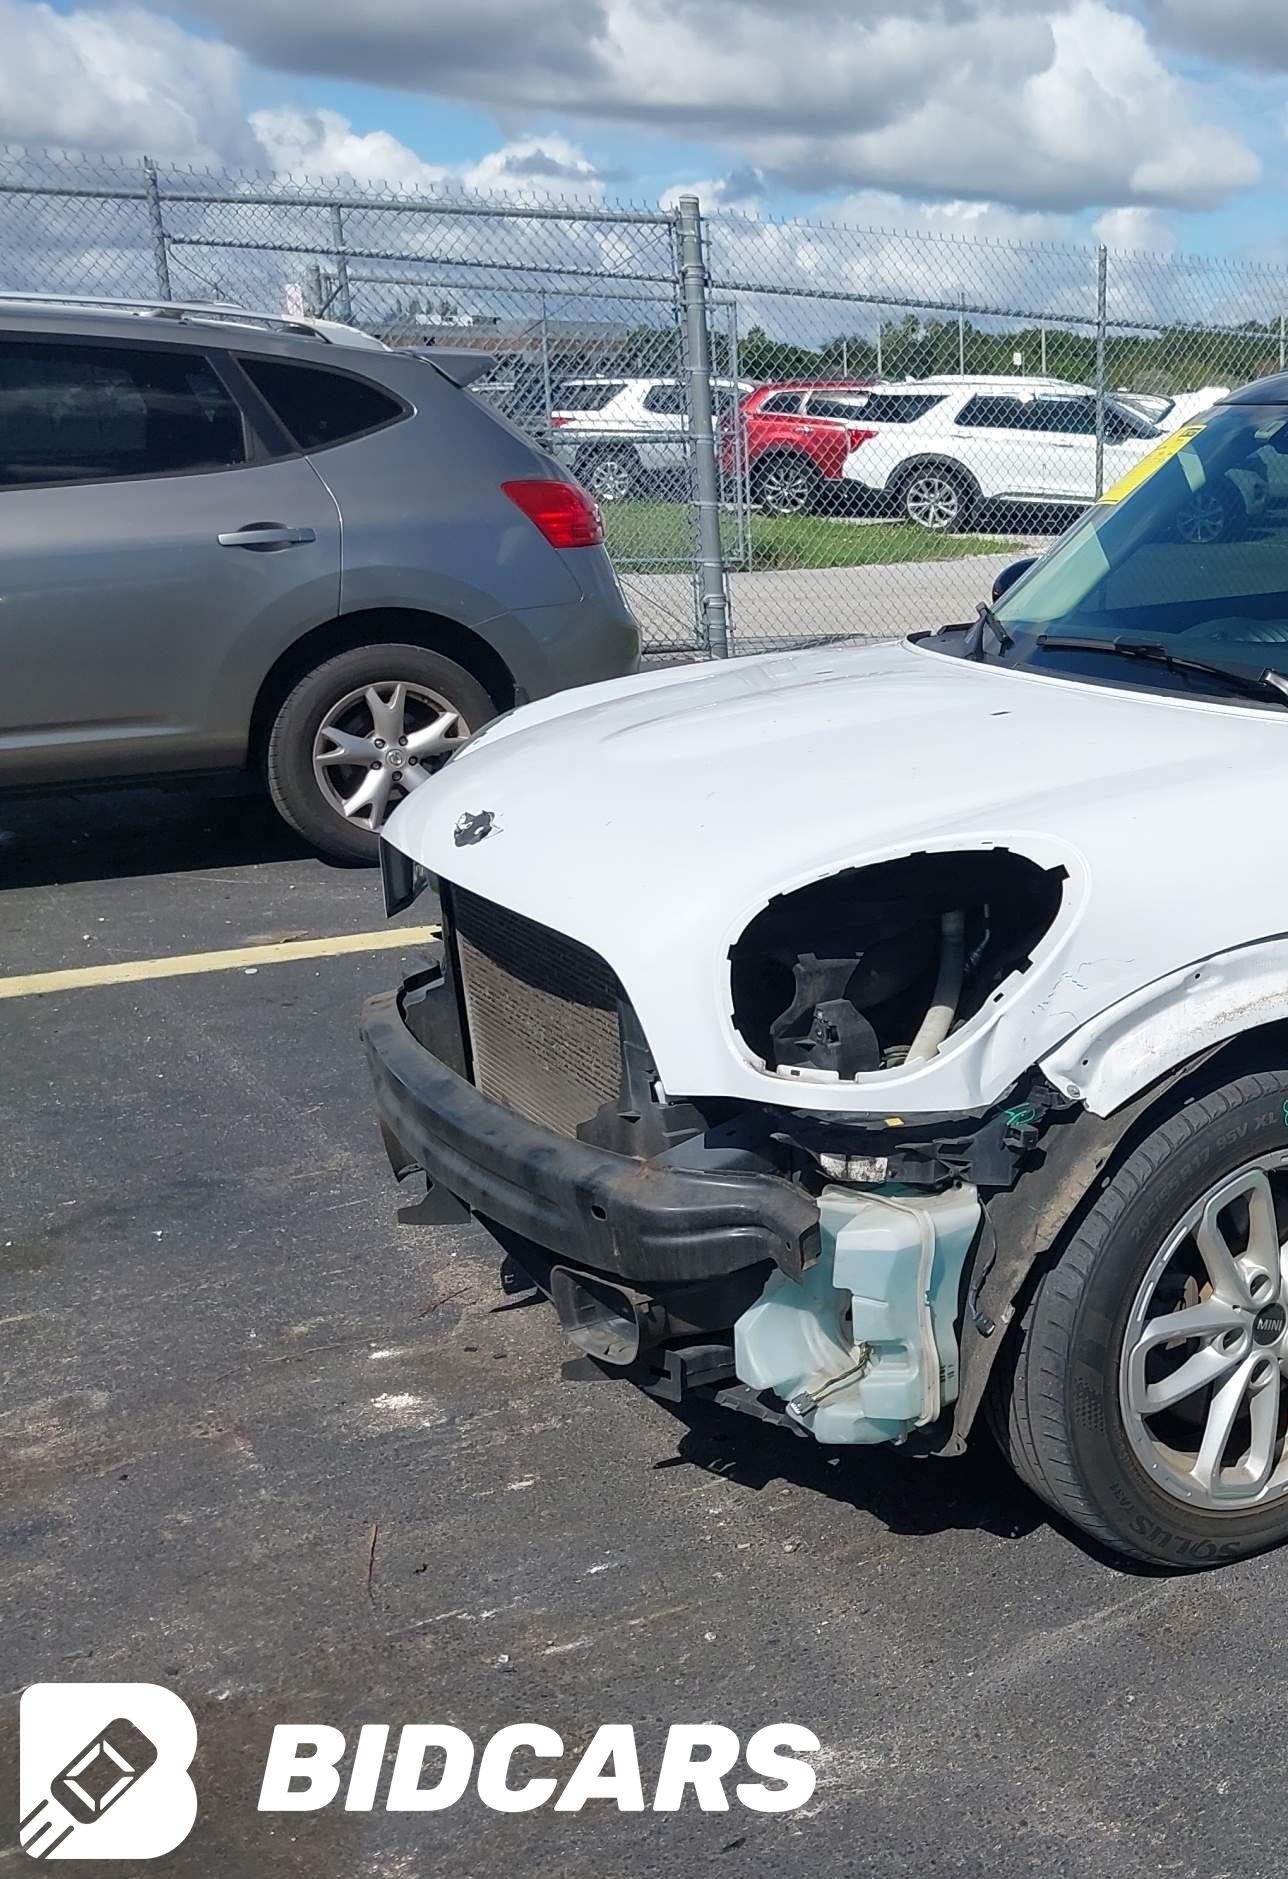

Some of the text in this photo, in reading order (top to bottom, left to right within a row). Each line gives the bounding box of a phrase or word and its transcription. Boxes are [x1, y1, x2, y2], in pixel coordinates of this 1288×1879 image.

[1215, 1122, 1249, 1152] 95V
[1253, 1111, 1278, 1131] XL
[1256, 1318, 1284, 1331] MINI
[1128, 1513, 1241, 1559] SOLUS
